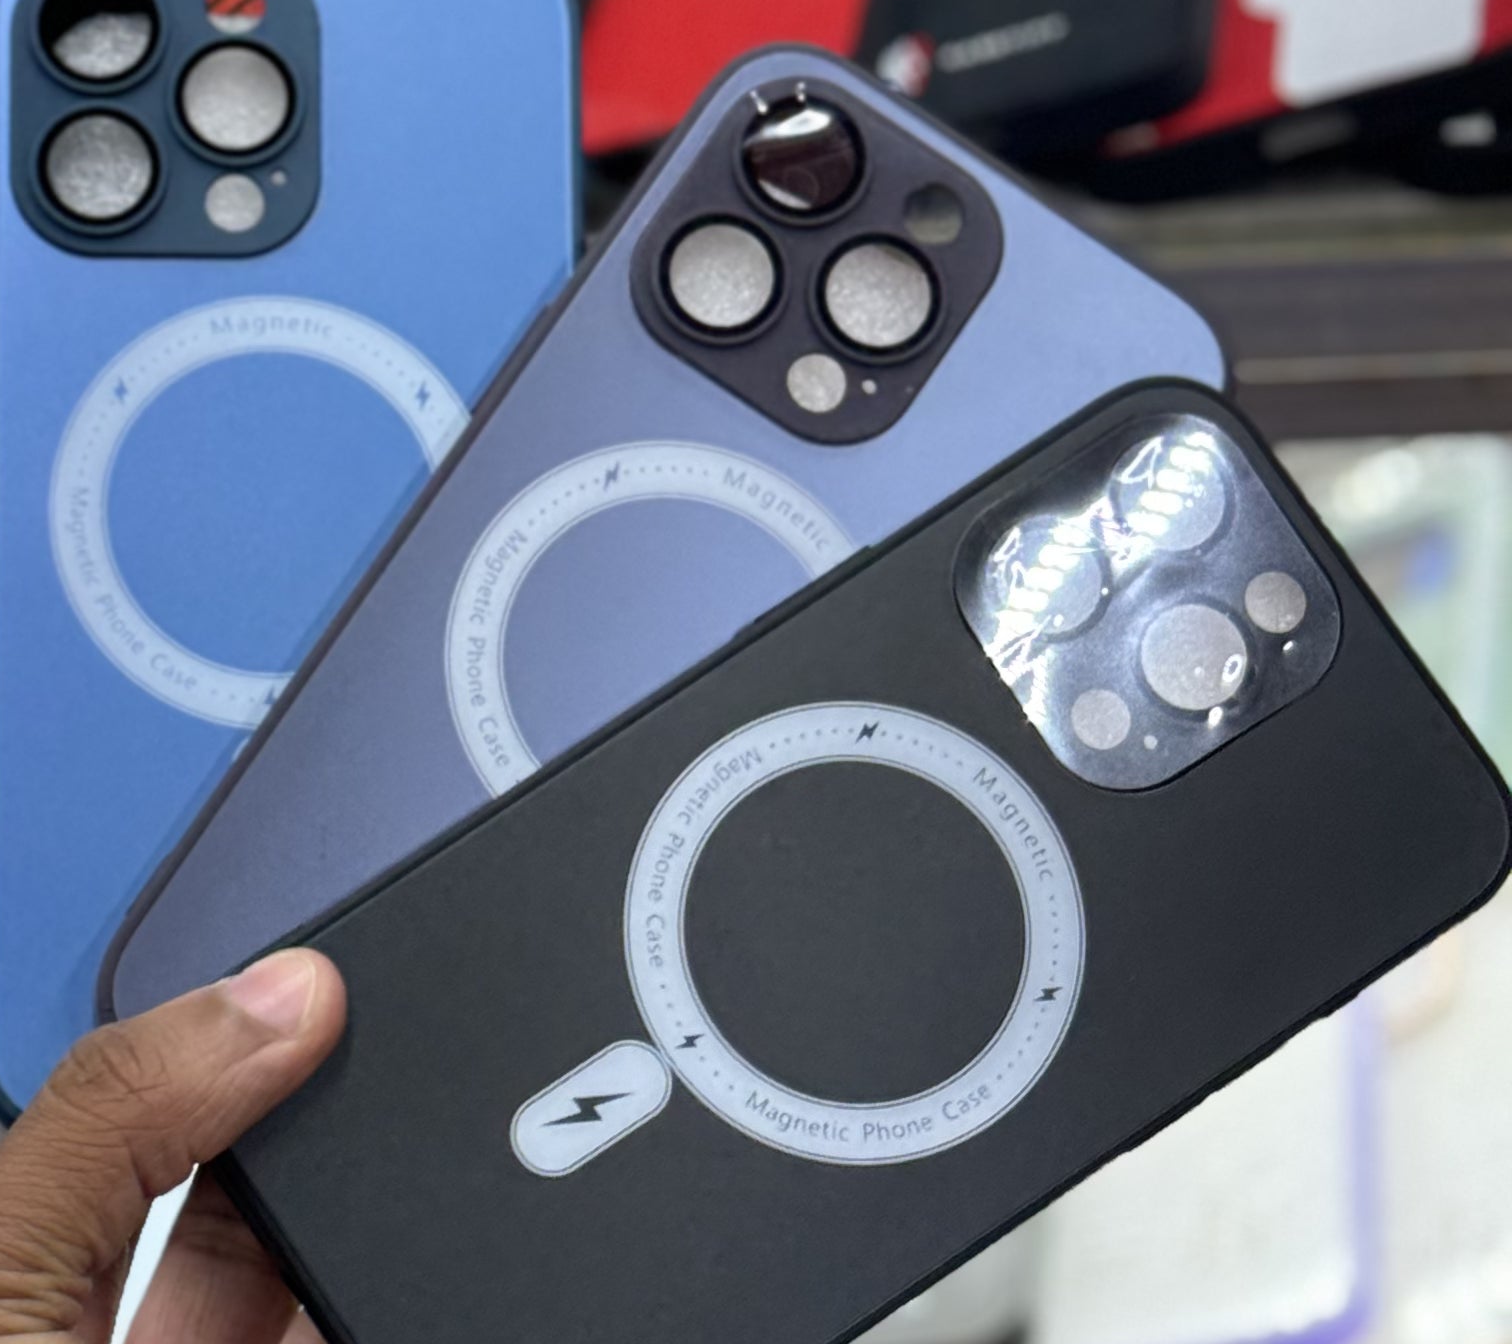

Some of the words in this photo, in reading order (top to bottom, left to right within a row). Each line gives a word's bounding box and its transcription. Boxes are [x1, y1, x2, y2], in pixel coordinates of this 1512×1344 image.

[210, 315, 334, 337] Magnetic
[722, 466, 831, 552] Magnetic
[63, 487, 99, 586] Magnetic
[95, 593, 144, 655] Phone
[149, 652, 199, 691] Case
[468, 533, 527, 626] Magnetic
[468, 637, 489, 708] Phone
[478, 717, 510, 768] Case
[675, 745, 763, 827] Magnetic
[973, 766, 1055, 881] Magnetic
[646, 832, 686, 904] Phone
[644, 913, 666, 969] Case
[744, 1089, 849, 1143] Magnetic
[862, 1113, 933, 1142] Phone
[942, 1083, 991, 1123] Case
